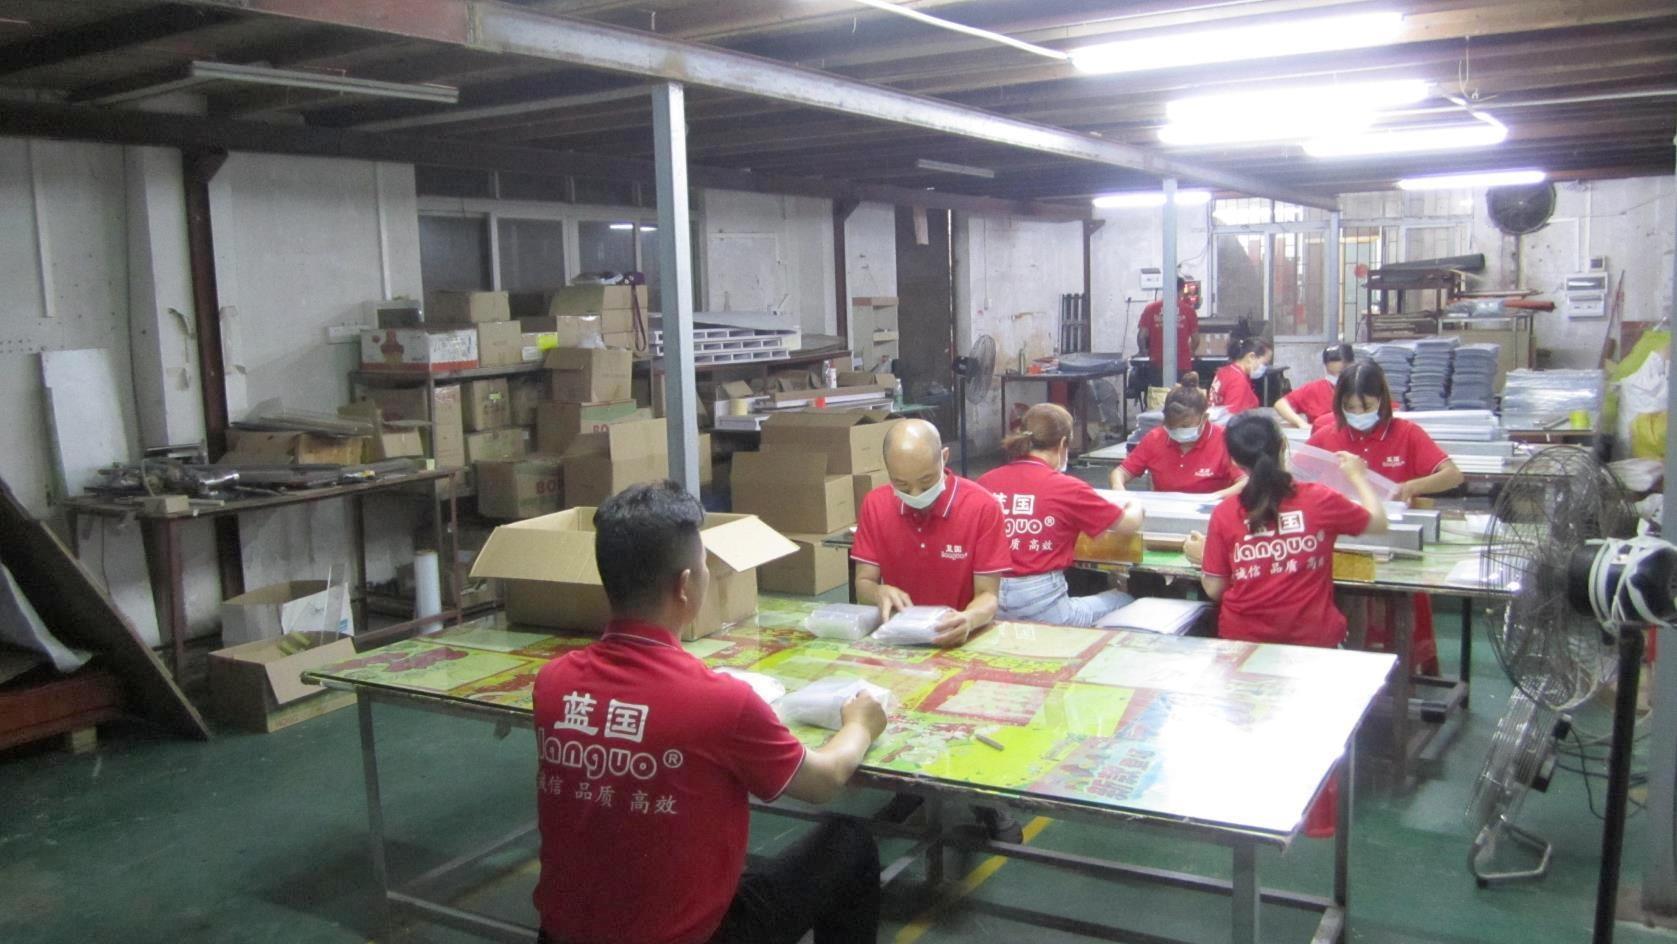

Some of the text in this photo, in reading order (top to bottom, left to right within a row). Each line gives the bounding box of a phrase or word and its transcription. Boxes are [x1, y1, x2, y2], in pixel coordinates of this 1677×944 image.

[1243, 510, 1305, 541] 国
[1233, 535, 1317, 562] languo
[553, 691, 649, 743] 蓝国
[575, 782, 616, 808] 品质
[630, 790, 678, 815] 高效
